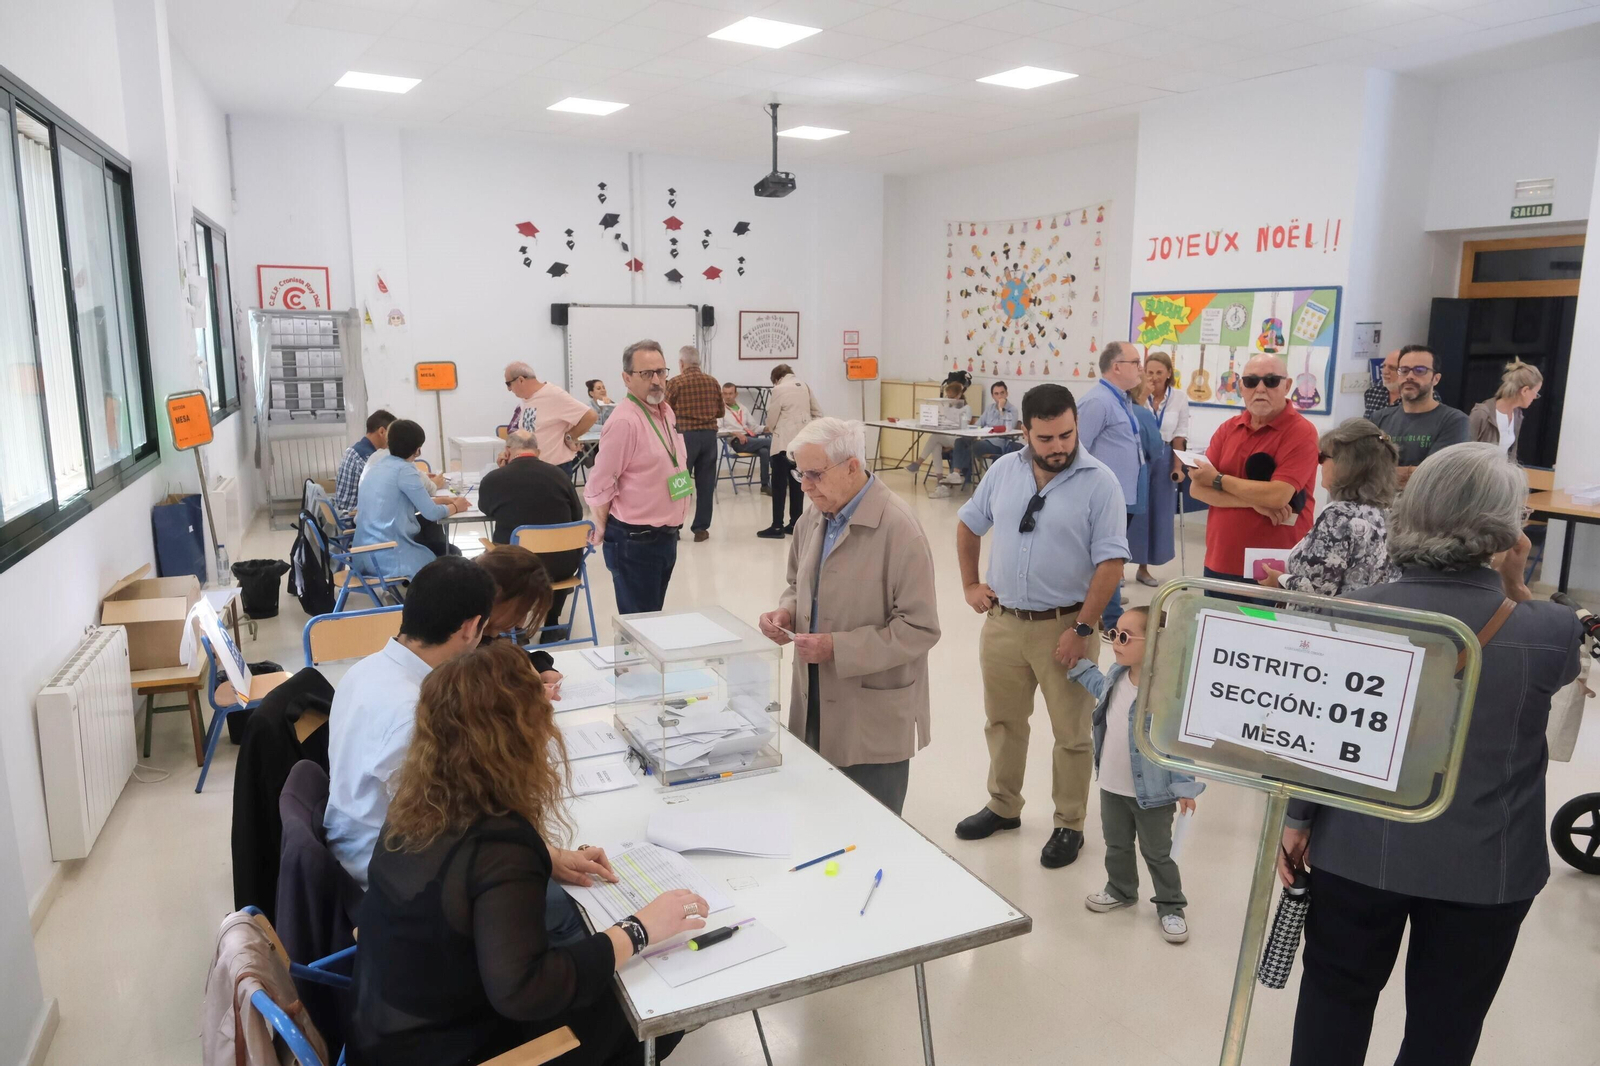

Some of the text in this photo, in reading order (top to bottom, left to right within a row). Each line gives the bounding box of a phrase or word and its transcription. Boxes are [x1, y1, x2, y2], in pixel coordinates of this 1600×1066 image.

[1513, 205, 1549, 217] SALIDA
[1146, 231, 1239, 262] JOYEUX
[279, 277, 304, 287] Cronista
[175, 414, 191, 424] MESA
[672, 475, 688, 489] VOX
[1212, 648, 1386, 697] DISTRITO: 02
[1209, 681, 1389, 733] SECCIÓN: 018
[1241, 722, 1362, 763] MESA: B
